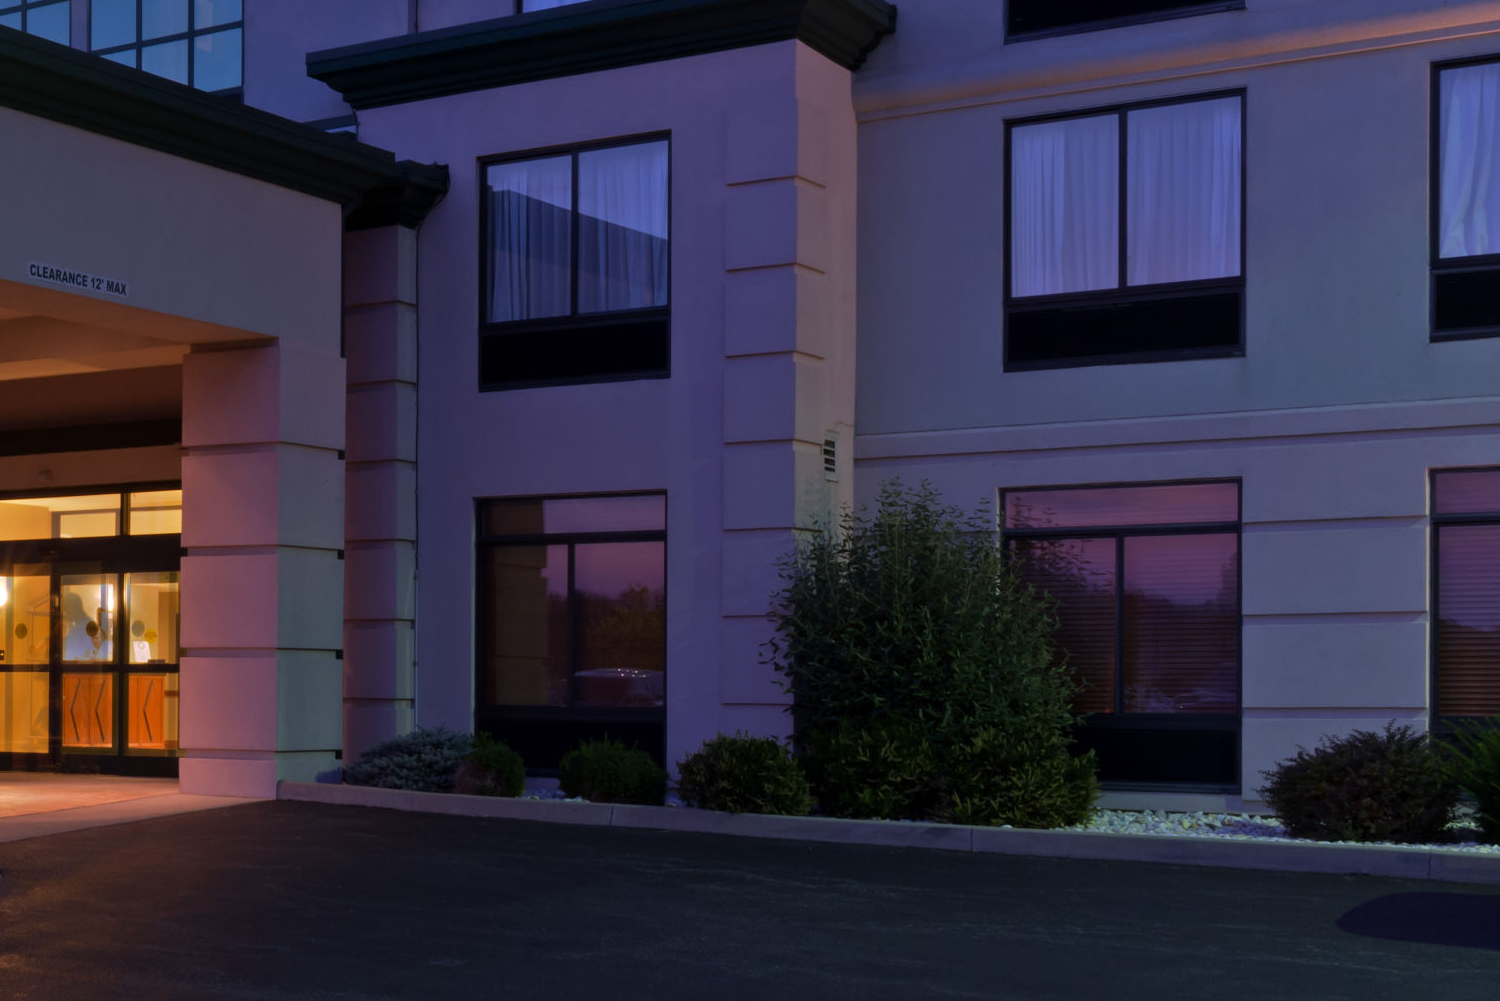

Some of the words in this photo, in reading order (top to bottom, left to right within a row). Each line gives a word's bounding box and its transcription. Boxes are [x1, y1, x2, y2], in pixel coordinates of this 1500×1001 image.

[29, 264, 88, 287] CLEARANCE
[91, 277, 104, 290] 12'
[106, 280, 127, 295] MAX
